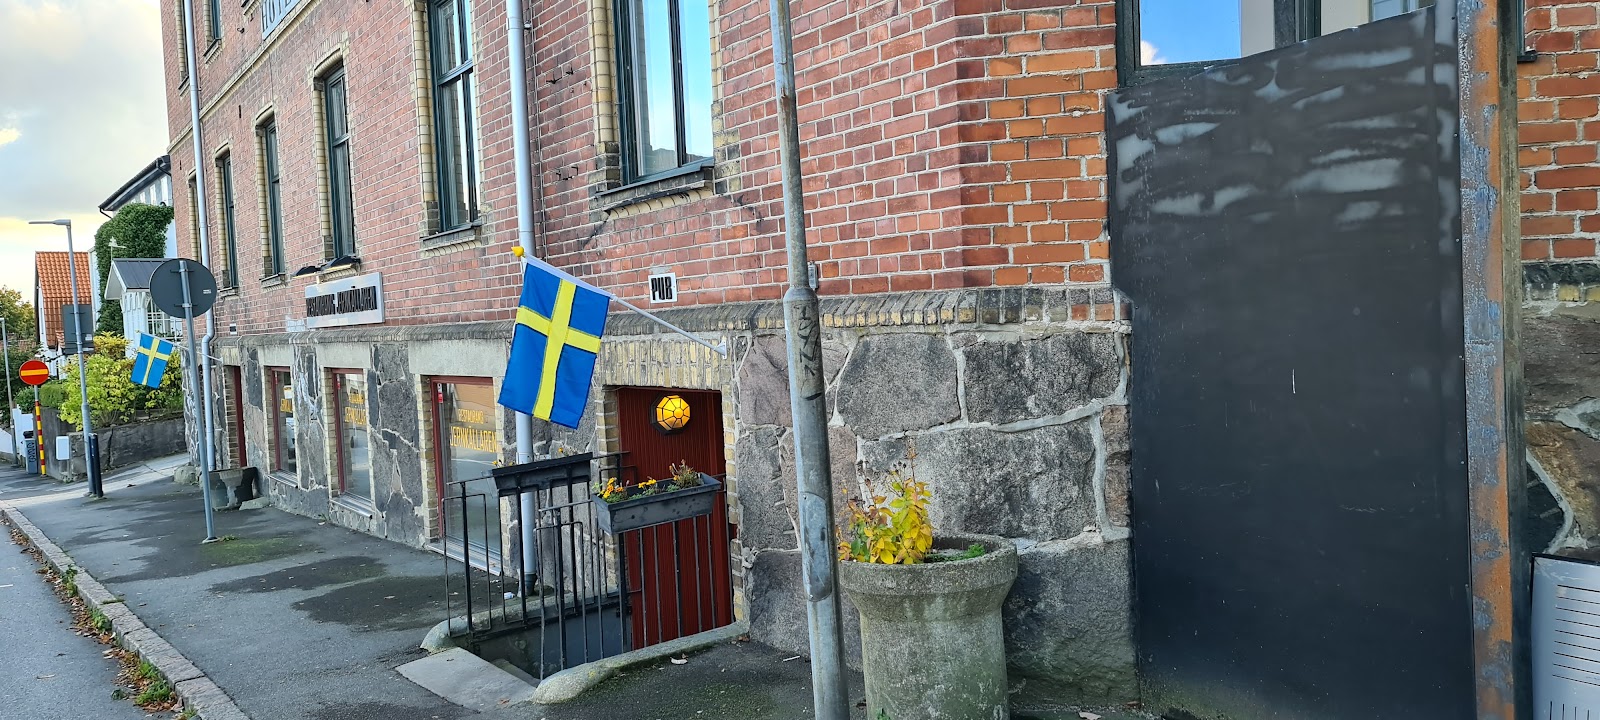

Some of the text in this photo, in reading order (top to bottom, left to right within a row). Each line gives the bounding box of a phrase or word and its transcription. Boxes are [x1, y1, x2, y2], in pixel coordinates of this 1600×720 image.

[651, 276, 673, 300] PUB
[458, 408, 484, 424] RESTAURANG
[450, 425, 497, 453] JERNKÄLLAREN
